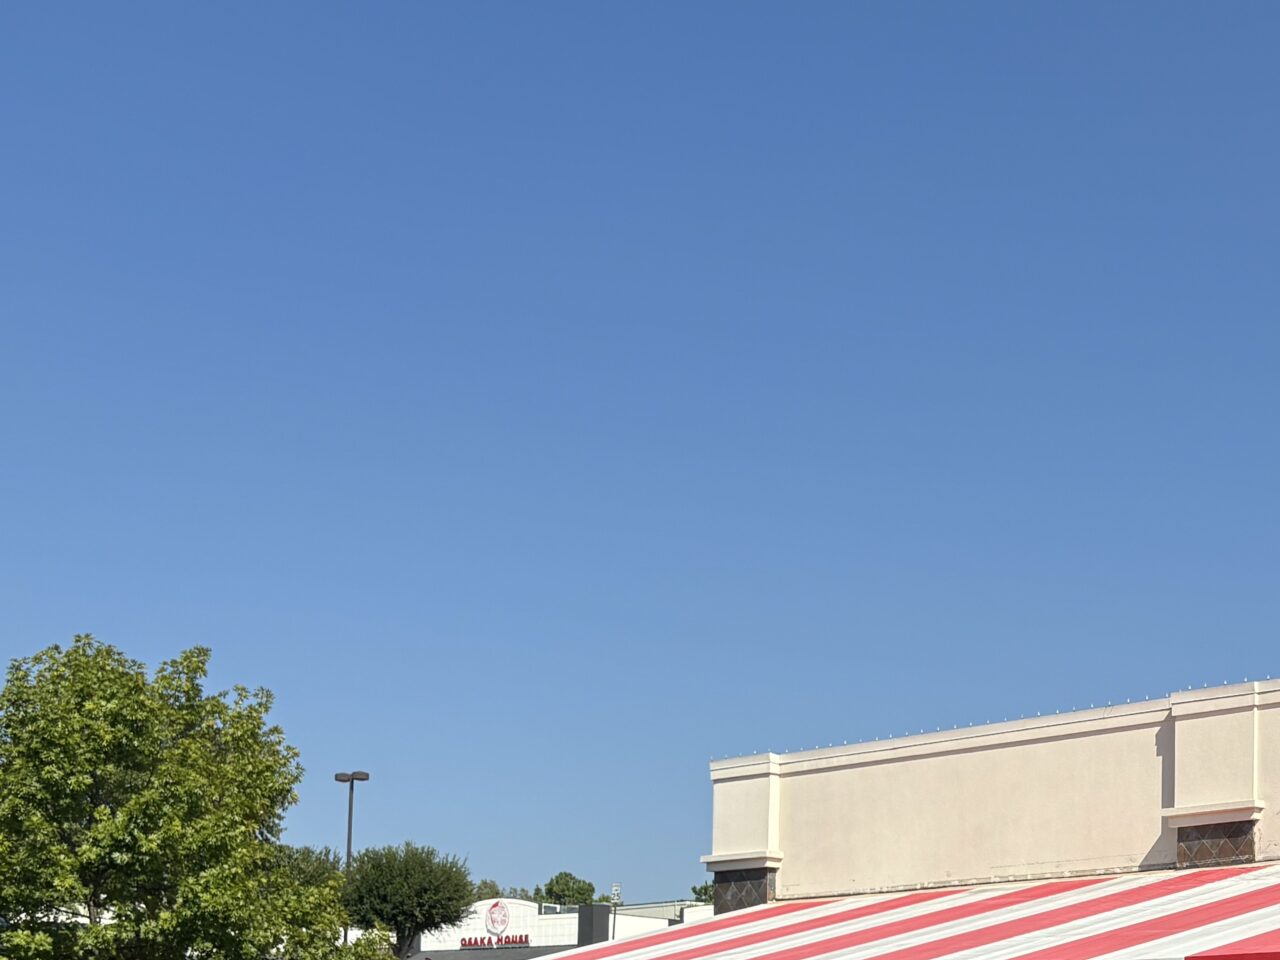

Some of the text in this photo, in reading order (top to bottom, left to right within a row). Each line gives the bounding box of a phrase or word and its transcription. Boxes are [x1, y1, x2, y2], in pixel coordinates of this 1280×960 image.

[611, 892, 621, 901] 25
[460, 934, 529, 948] OSAKA HOUSE
